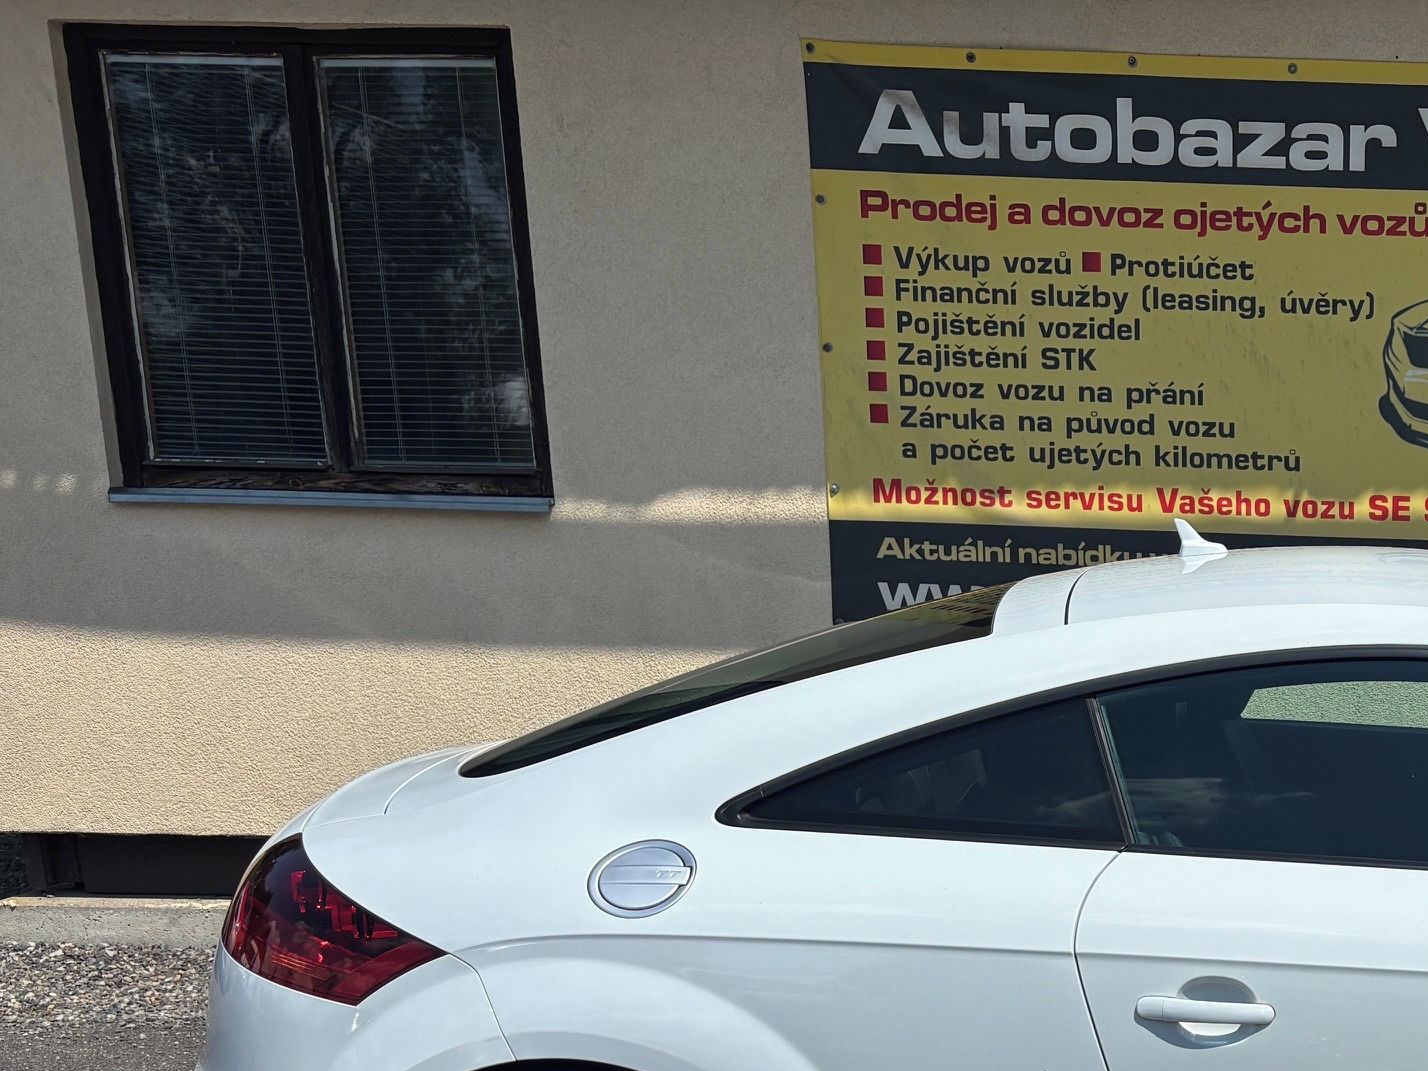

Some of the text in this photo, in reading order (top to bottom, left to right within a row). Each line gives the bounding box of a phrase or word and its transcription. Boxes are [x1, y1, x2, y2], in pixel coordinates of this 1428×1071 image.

[858, 90, 1397, 171] Autobazar
[859, 189, 998, 231] Prodej
[1008, 204, 1031, 225] a
[1042, 198, 1162, 229] dovoz
[1173, 200, 1327, 241] ojetých
[893, 246, 1071, 278] Výkup vozů
[1111, 254, 1254, 280] Protiúčet
[895, 279, 1374, 322] Finanční služby (leasing, úvěry)
[897, 311, 1140, 341] Pojištění vozidel
[898, 343, 1096, 372] Zajištění STK
[899, 374, 1204, 409] Dovoz vozu na přání
[900, 405, 1235, 439] Záruka na původ vozu
[902, 439, 1300, 472] a počet ujetých kilometrů
[872, 479, 1015, 510] Možnost
[1024, 485, 1145, 514] servisu
[1156, 487, 1272, 518] Vašeho
[1283, 498, 1357, 521] vozu
[1367, 494, 1412, 523] SE
[877, 537, 1012, 562] Aktuální
